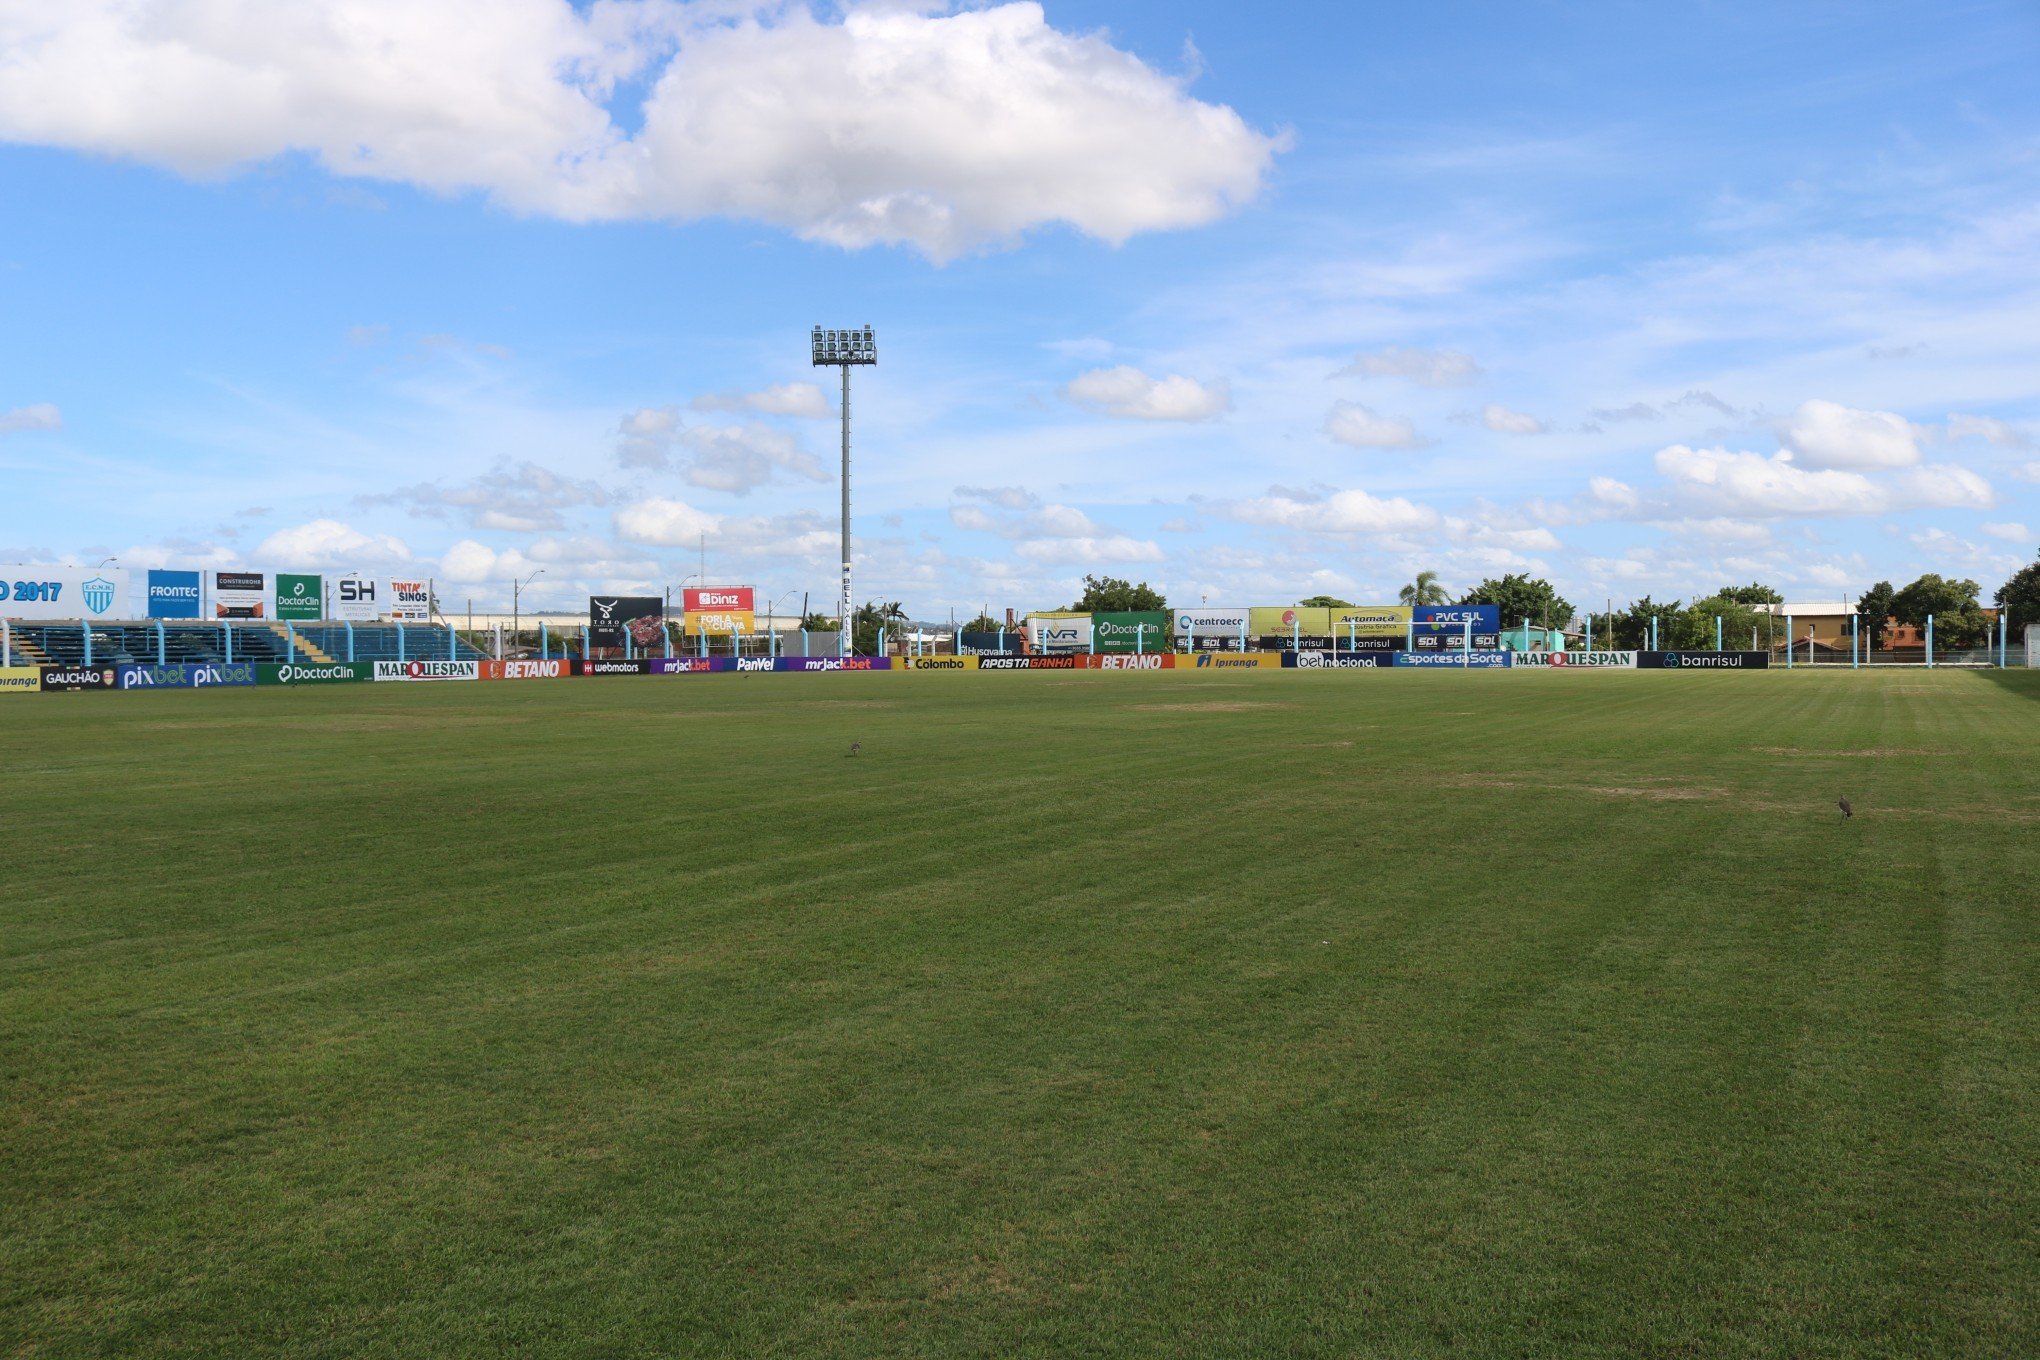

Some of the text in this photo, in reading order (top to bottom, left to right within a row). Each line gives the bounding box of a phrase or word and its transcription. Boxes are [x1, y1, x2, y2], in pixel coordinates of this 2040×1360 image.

[13, 581, 62, 601] 2017
[150, 586, 198, 597] FRONTEC
[340, 580, 375, 601] SH
[398, 592, 427, 602] SINOS
[843, 578, 851, 604] BELL
[278, 596, 319, 605] DoctorClin
[1435, 612, 1459, 621] PVC
[1112, 624, 1159, 634] DoctoClin
[967, 646, 1013, 656] Husqvana
[916, 658, 965, 669] Colombo
[1101, 655, 1162, 669] BETANO
[1215, 658, 1258, 668] Ipiranga
[1470, 653, 1503, 664] Sorte
[1516, 652, 1630, 666] MARQUESPAN
[1681, 654, 1742, 667] banrisul
[294, 666, 354, 679] DoctorClin
[378, 661, 474, 677] MARQUESPAN
[504, 661, 560, 678] BETANO
[595, 662, 639, 673] webmotors
[46, 670, 100, 684] GAUCHÃO
[124, 664, 187, 689] pixbet
[194, 663, 253, 687] pixbet
